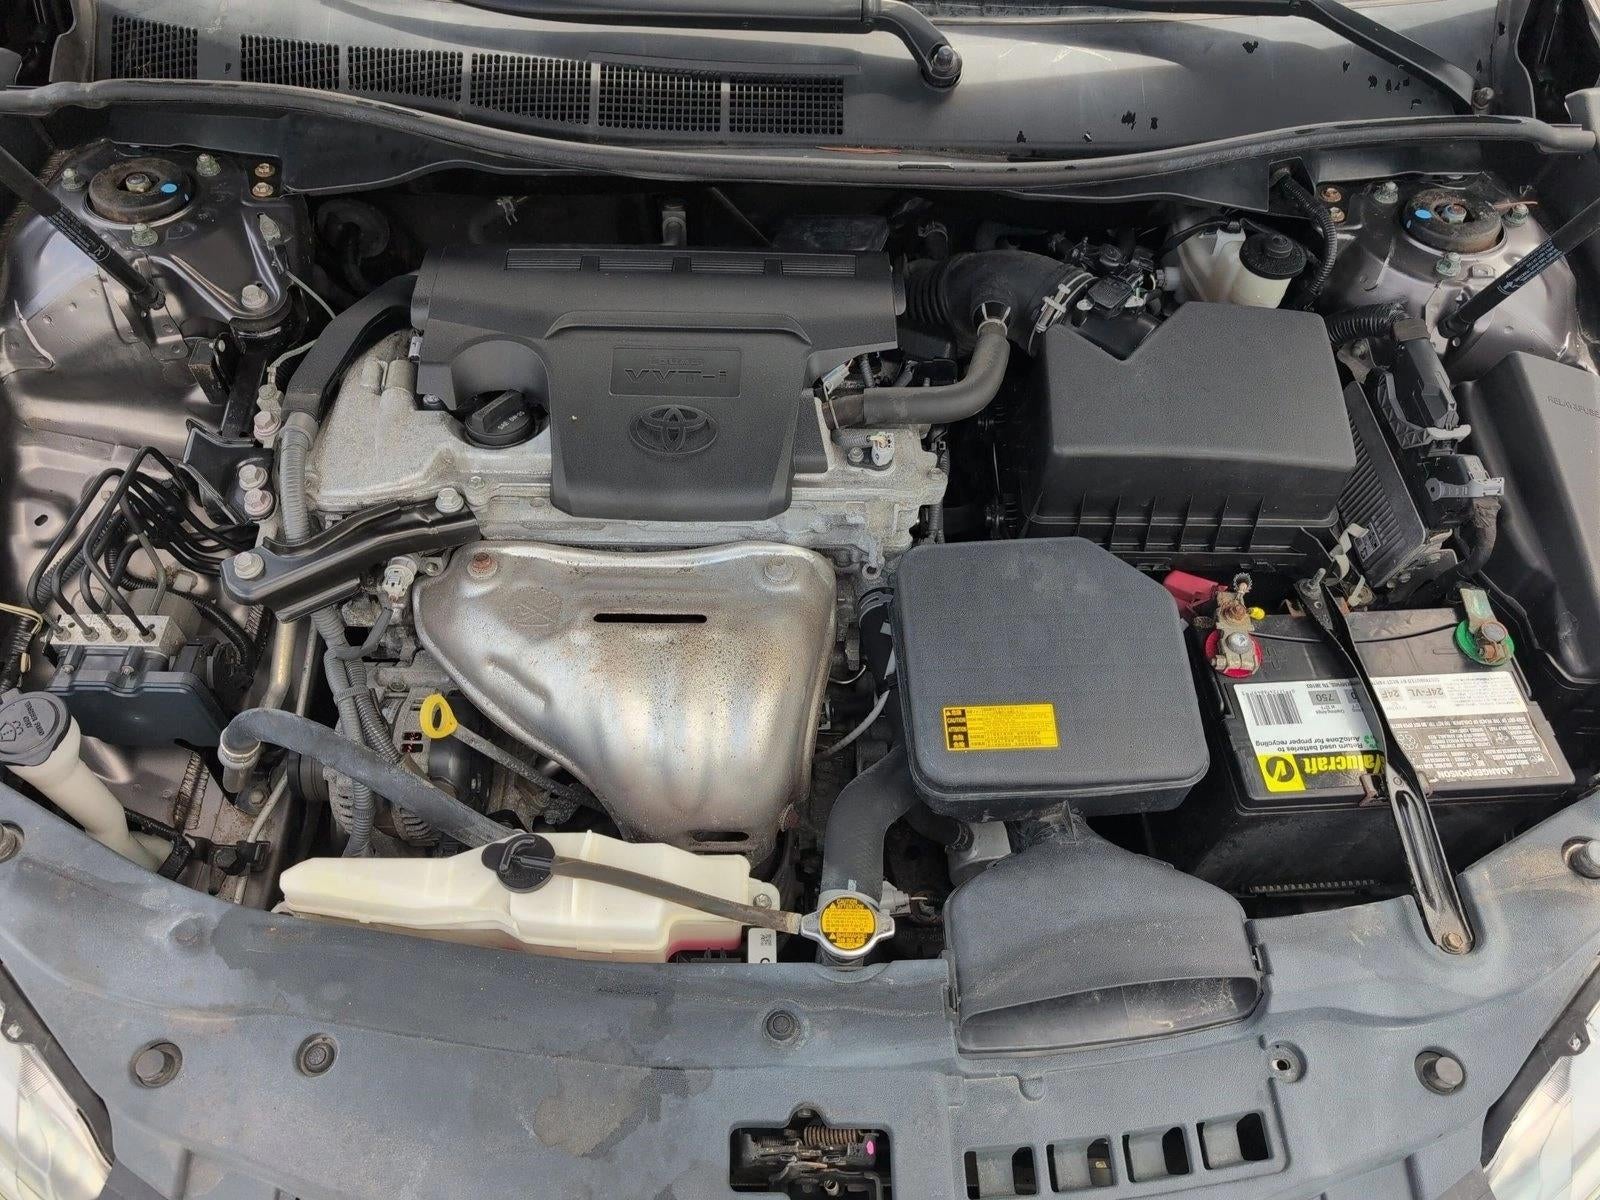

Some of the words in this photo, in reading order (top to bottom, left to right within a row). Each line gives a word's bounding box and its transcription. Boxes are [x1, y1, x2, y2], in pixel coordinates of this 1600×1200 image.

[624, 368, 726, 384] VVT-i
[1316, 693, 1334, 702] 750
[1255, 739, 1287, 747] recycling
[1289, 737, 1312, 745] proper
[1326, 736, 1360, 744] AutoZone
[1304, 754, 1382, 774] Valucraft
